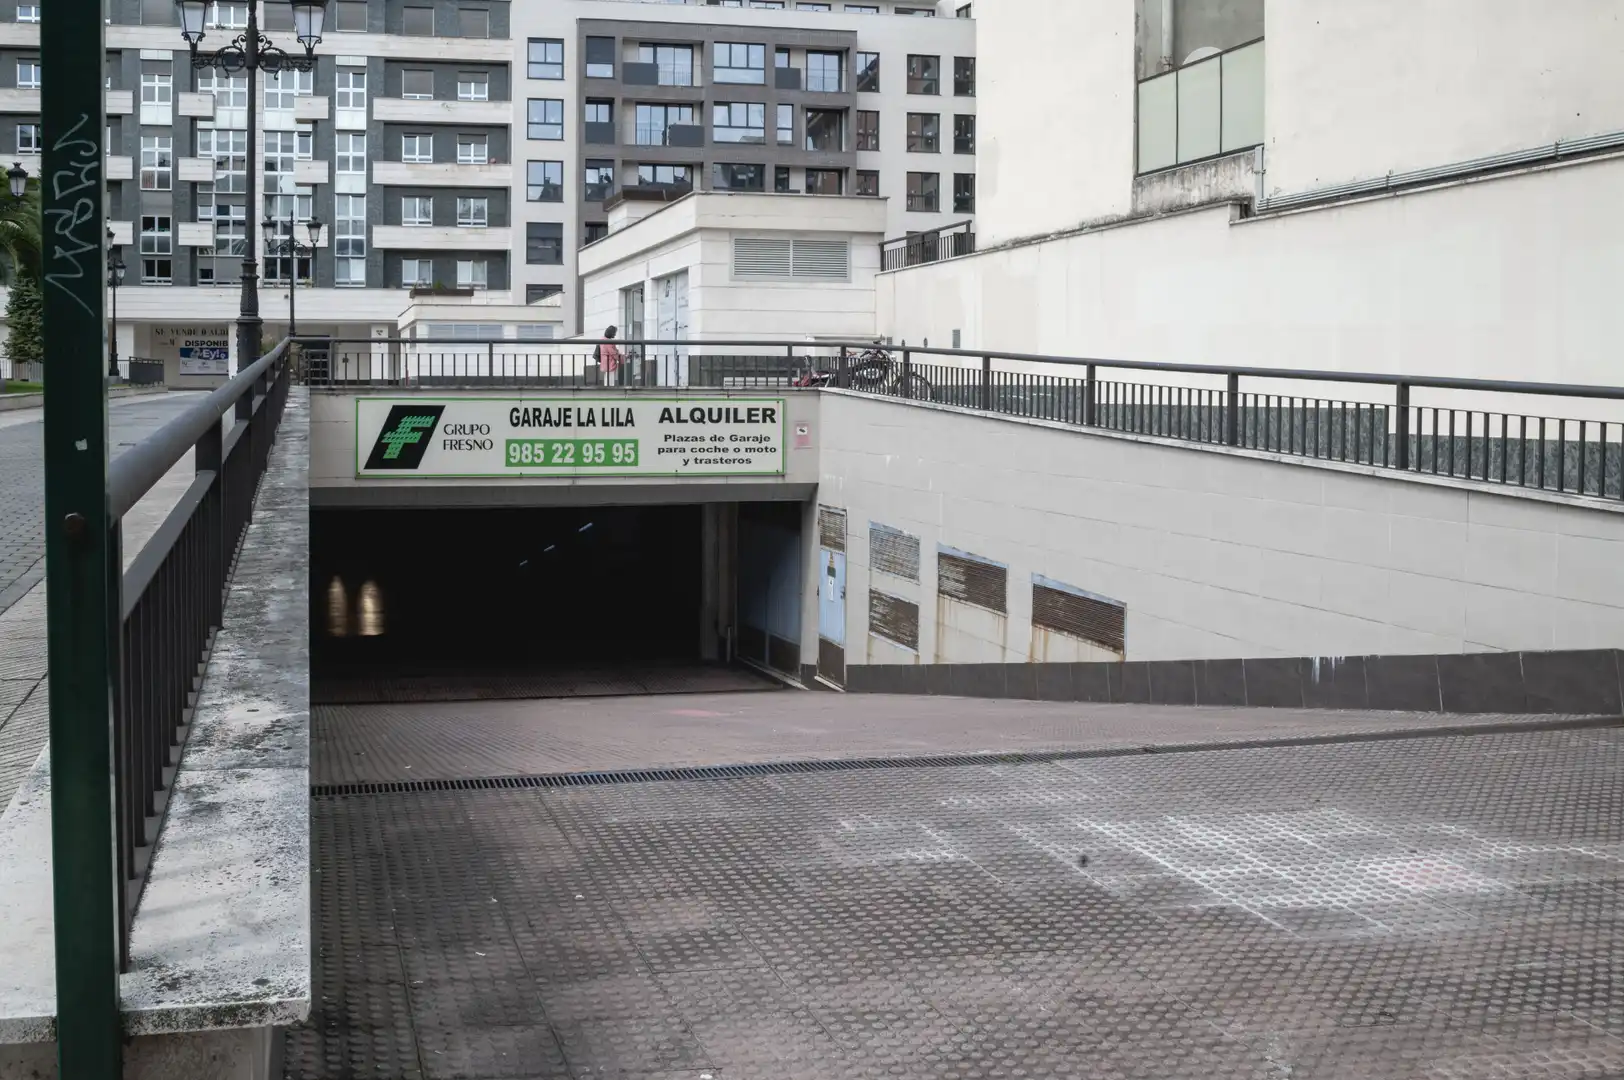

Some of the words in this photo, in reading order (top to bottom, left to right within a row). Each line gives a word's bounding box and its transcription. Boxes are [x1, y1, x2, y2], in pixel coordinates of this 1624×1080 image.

[509, 406, 572, 427] GARAJE
[577, 406, 597, 427] LA
[601, 406, 635, 427] LILA
[658, 407, 776, 424] ALQUILER
[443, 423, 491, 436] GRUPO
[443, 438, 494, 451] FRESNO
[663, 434, 706, 443] Plazas
[709, 434, 725, 443] de
[729, 434, 771, 444] Garaje
[509, 442, 545, 463] 985
[551, 442, 575, 463] 22
[582, 442, 605, 463] 95
[612, 442, 635, 463] 95
[657, 446, 686, 455] para
[690, 445, 729, 454] coche
[744, 446, 777, 454] moto
[682, 457, 690, 466] y
[693, 457, 752, 465] trasteros
